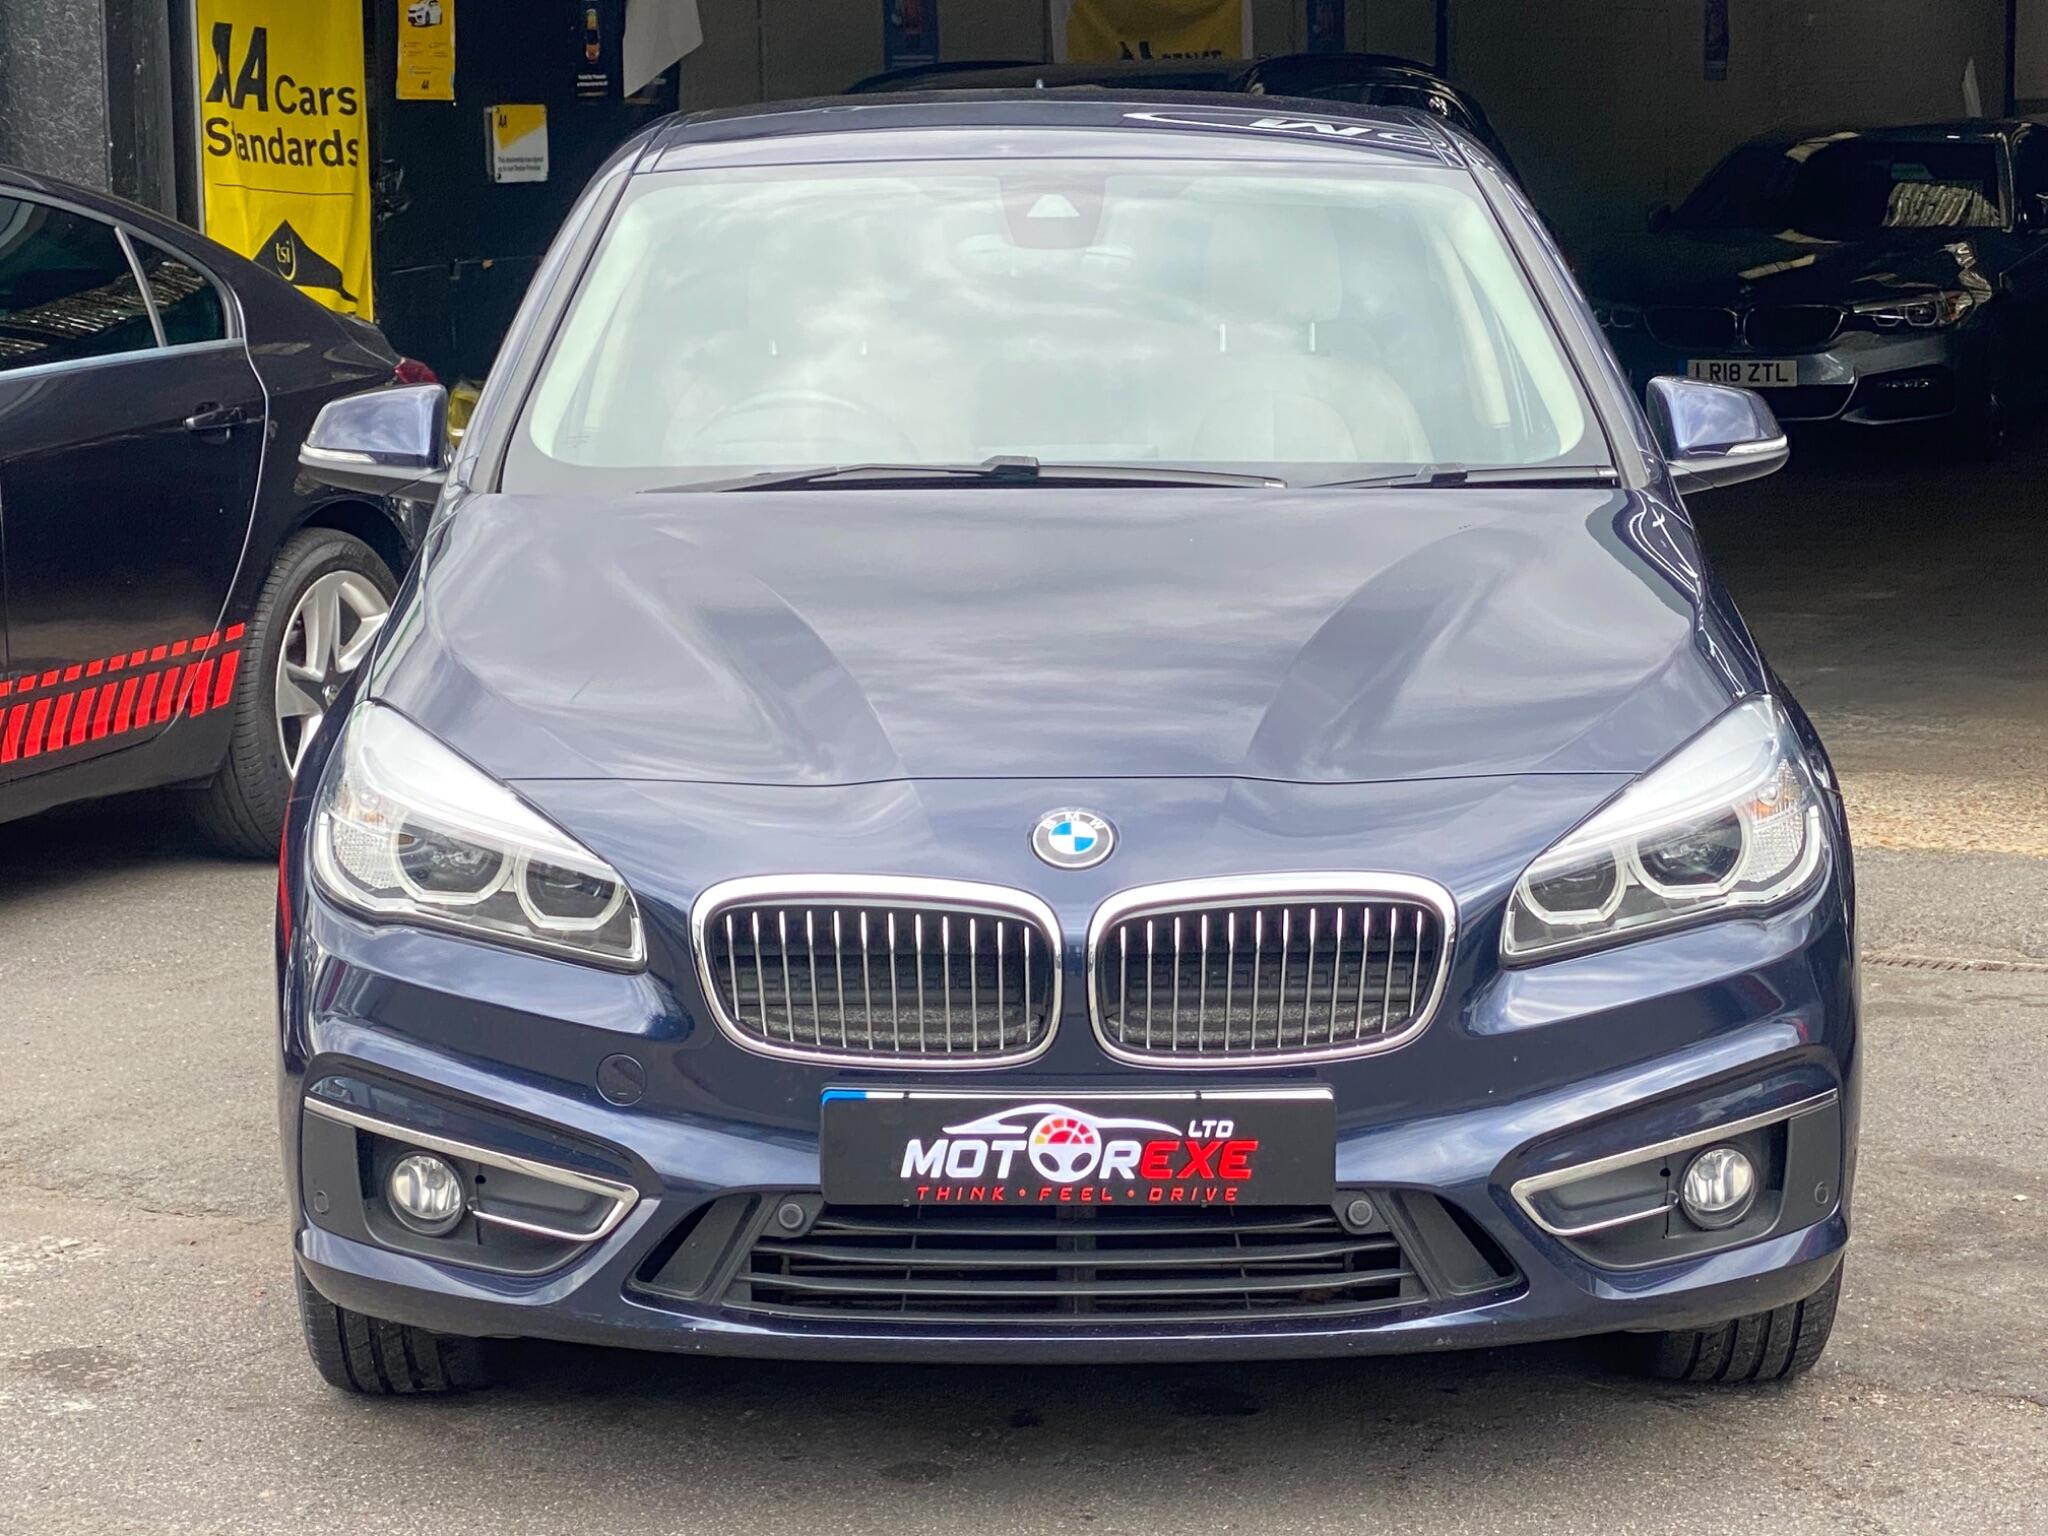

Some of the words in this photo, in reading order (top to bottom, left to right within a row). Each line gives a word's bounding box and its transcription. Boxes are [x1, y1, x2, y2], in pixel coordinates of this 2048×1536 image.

[275, 74, 358, 116] Cars
[205, 117, 359, 167] Sandards
[276, 241, 290, 263] tsi
[1747, 363, 1788, 382] ZTL
[1188, 1119, 1234, 1138] LTD
[917, 1186, 1005, 1201] THINK
[1039, 1186, 1113, 1201] FEEL
[1148, 1187, 1239, 1201] DRIVE
